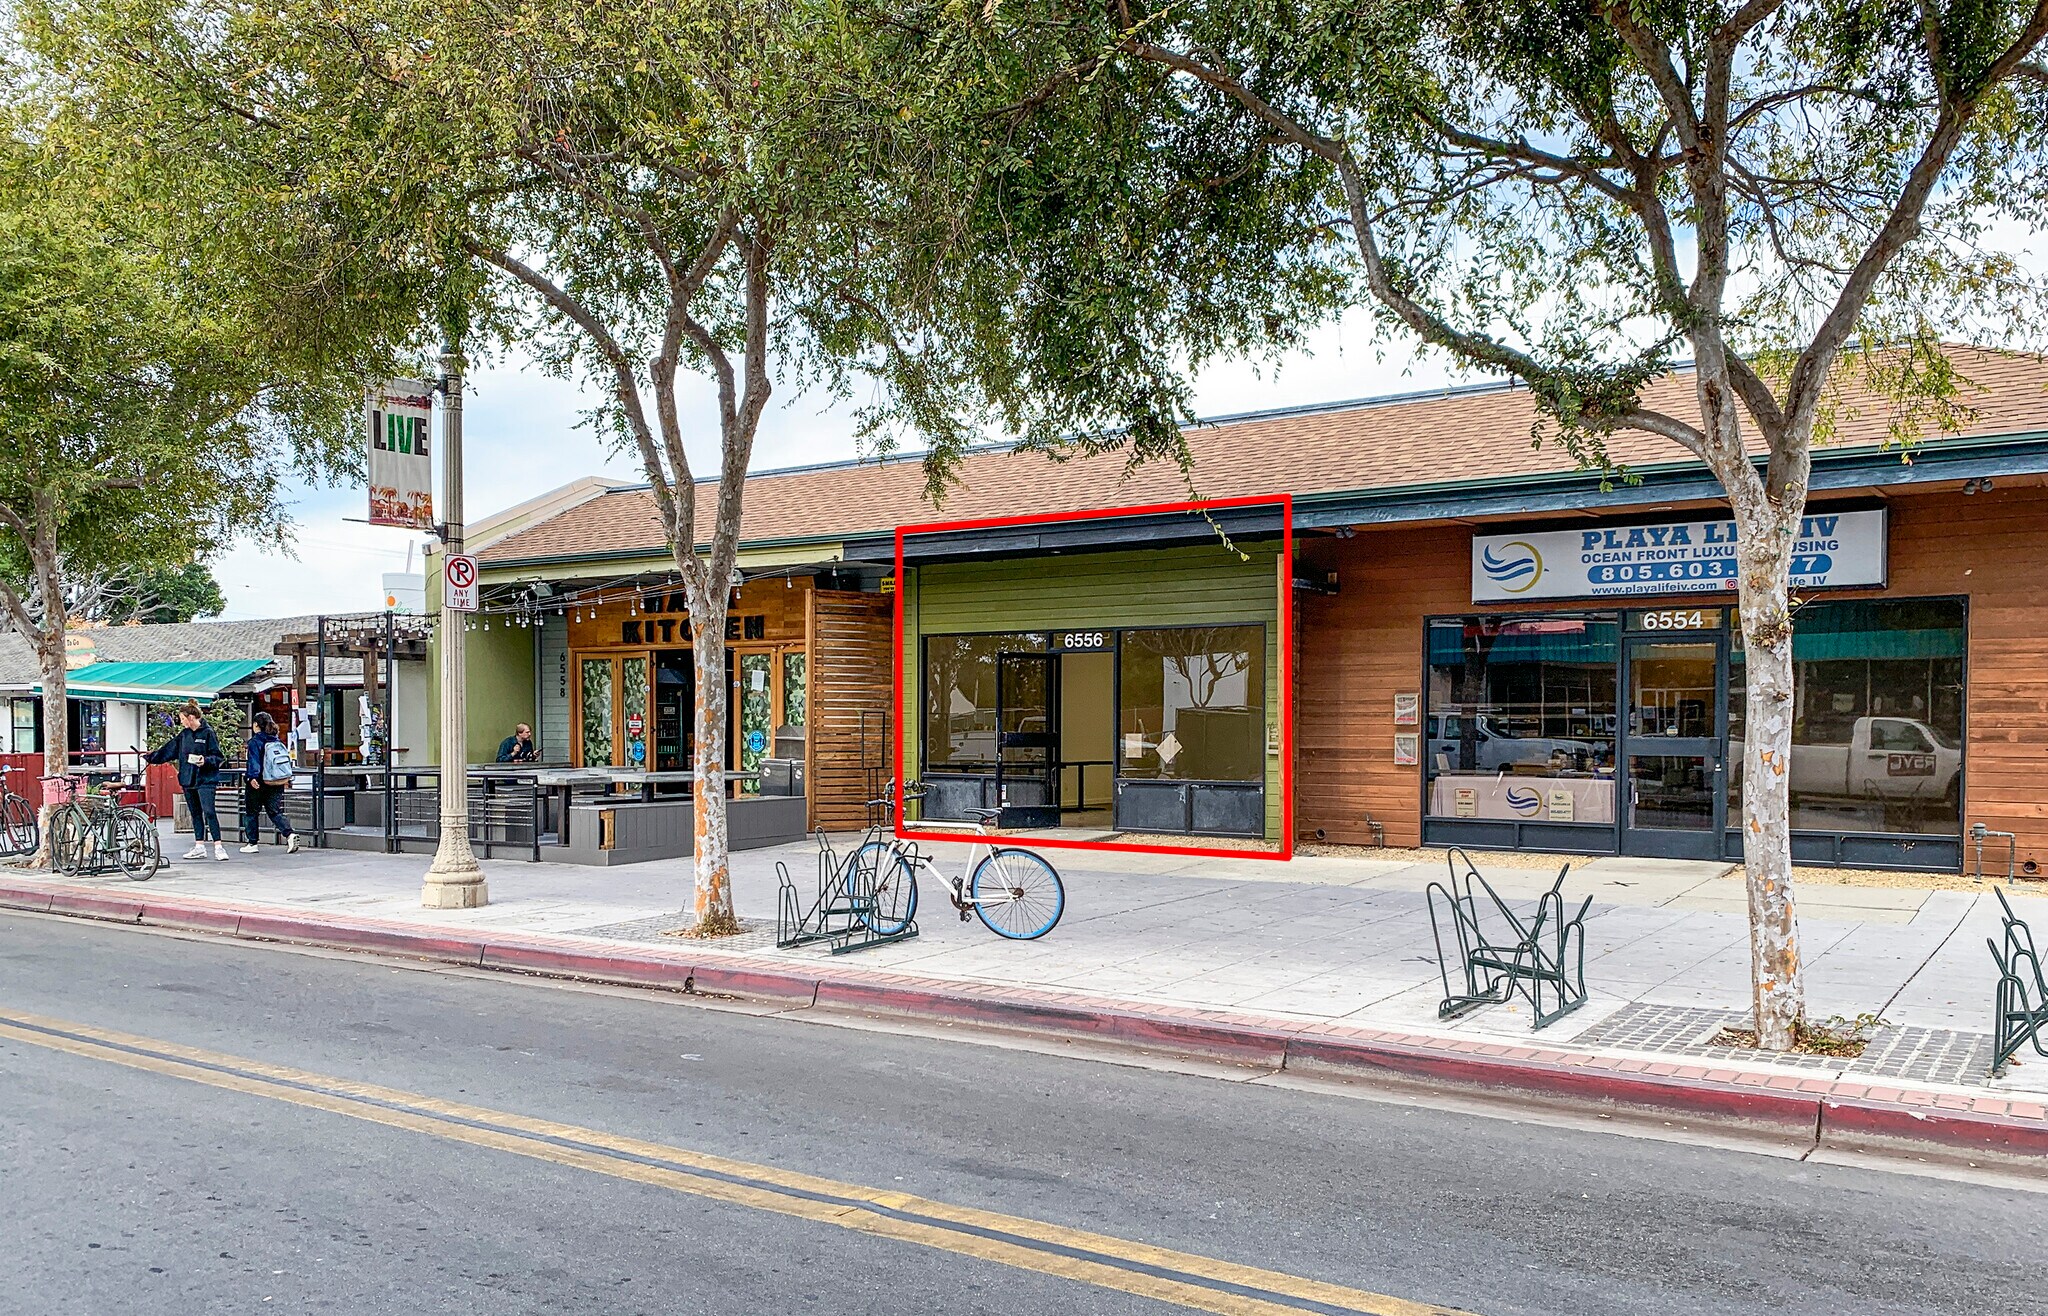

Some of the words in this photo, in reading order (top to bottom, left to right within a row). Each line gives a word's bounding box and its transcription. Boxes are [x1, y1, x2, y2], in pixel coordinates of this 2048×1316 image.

[372, 410, 428, 457] LIVE
[1581, 525, 1692, 551] PLAYA
[1581, 552, 1632, 564] OCEAN
[1637, 549, 1688, 560] FRONT
[1692, 546, 1736, 557] LUXU
[1592, 582, 1717, 594] www.playalifeiv.com
[1789, 577, 1806, 585] ife
[1812, 575, 1827, 585] IV
[453, 590, 469, 598] ANY
[453, 598, 470, 607] TIME
[1643, 611, 1704, 630] 6554
[622, 615, 765, 643] KITCEN
[1064, 633, 1103, 648] 6556
